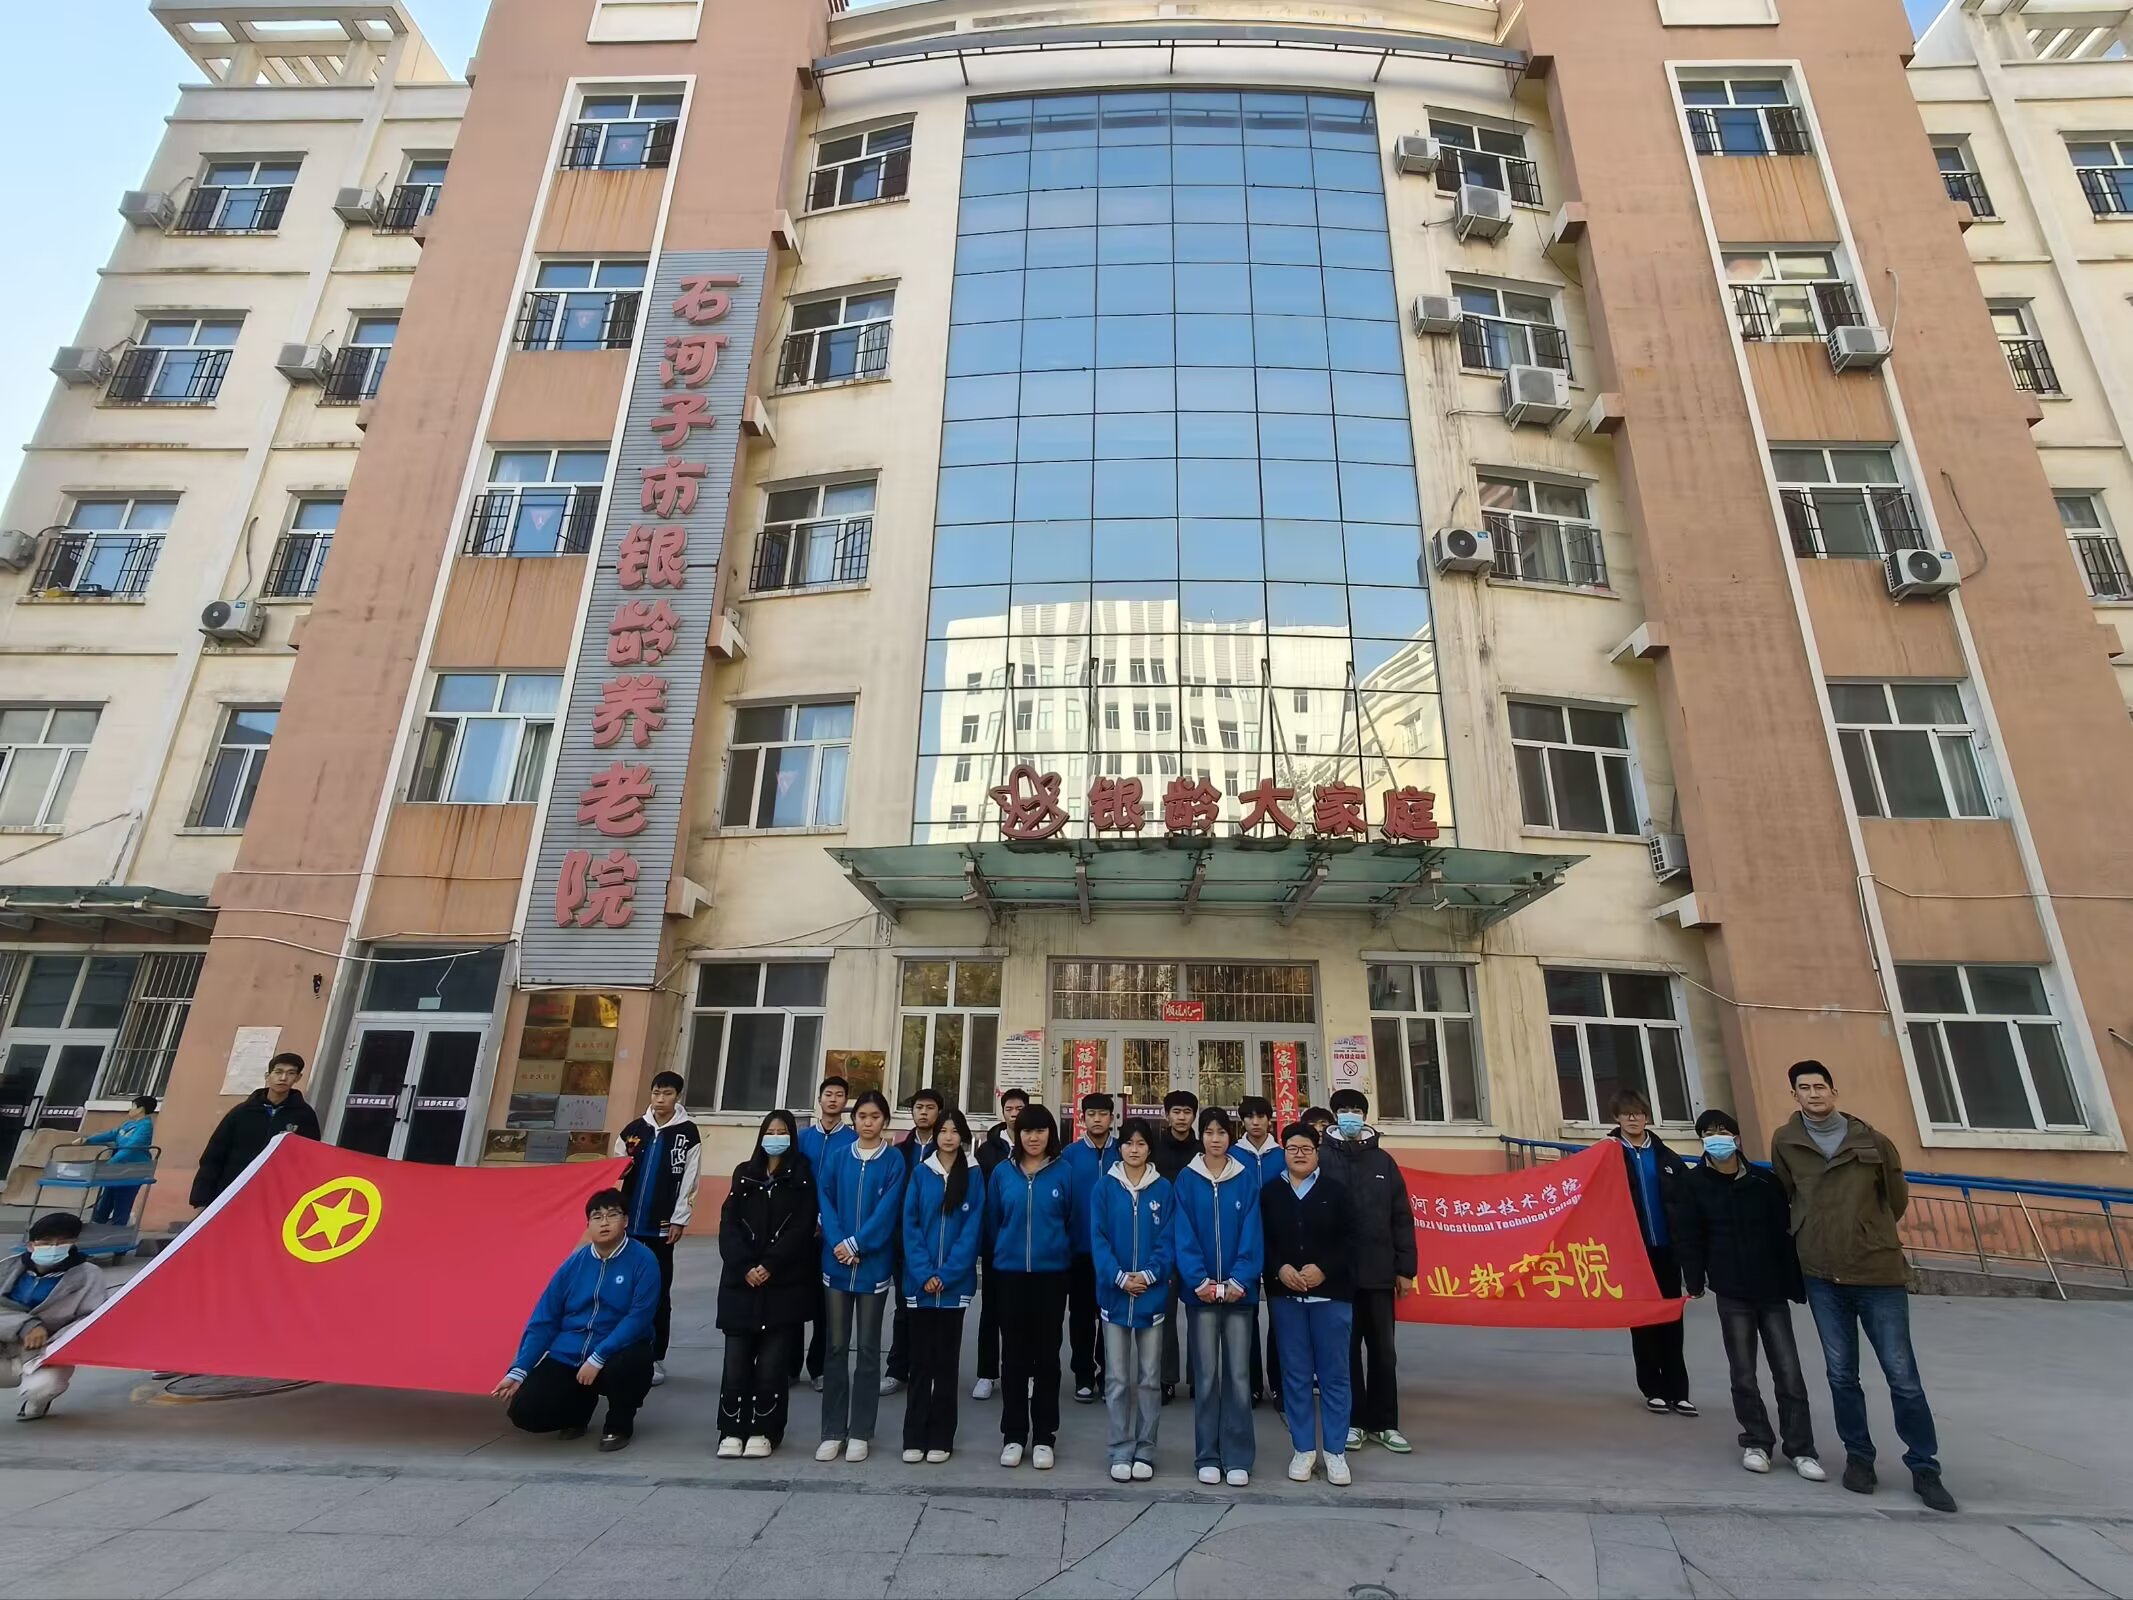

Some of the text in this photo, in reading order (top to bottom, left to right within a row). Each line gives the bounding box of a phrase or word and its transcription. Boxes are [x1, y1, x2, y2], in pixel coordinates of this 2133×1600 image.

[555, 272, 743, 929] 石河子市银龄养老院
[1087, 776, 1440, 841] 银龄大家庭
[1436, 1220, 1495, 1233] Vocational
